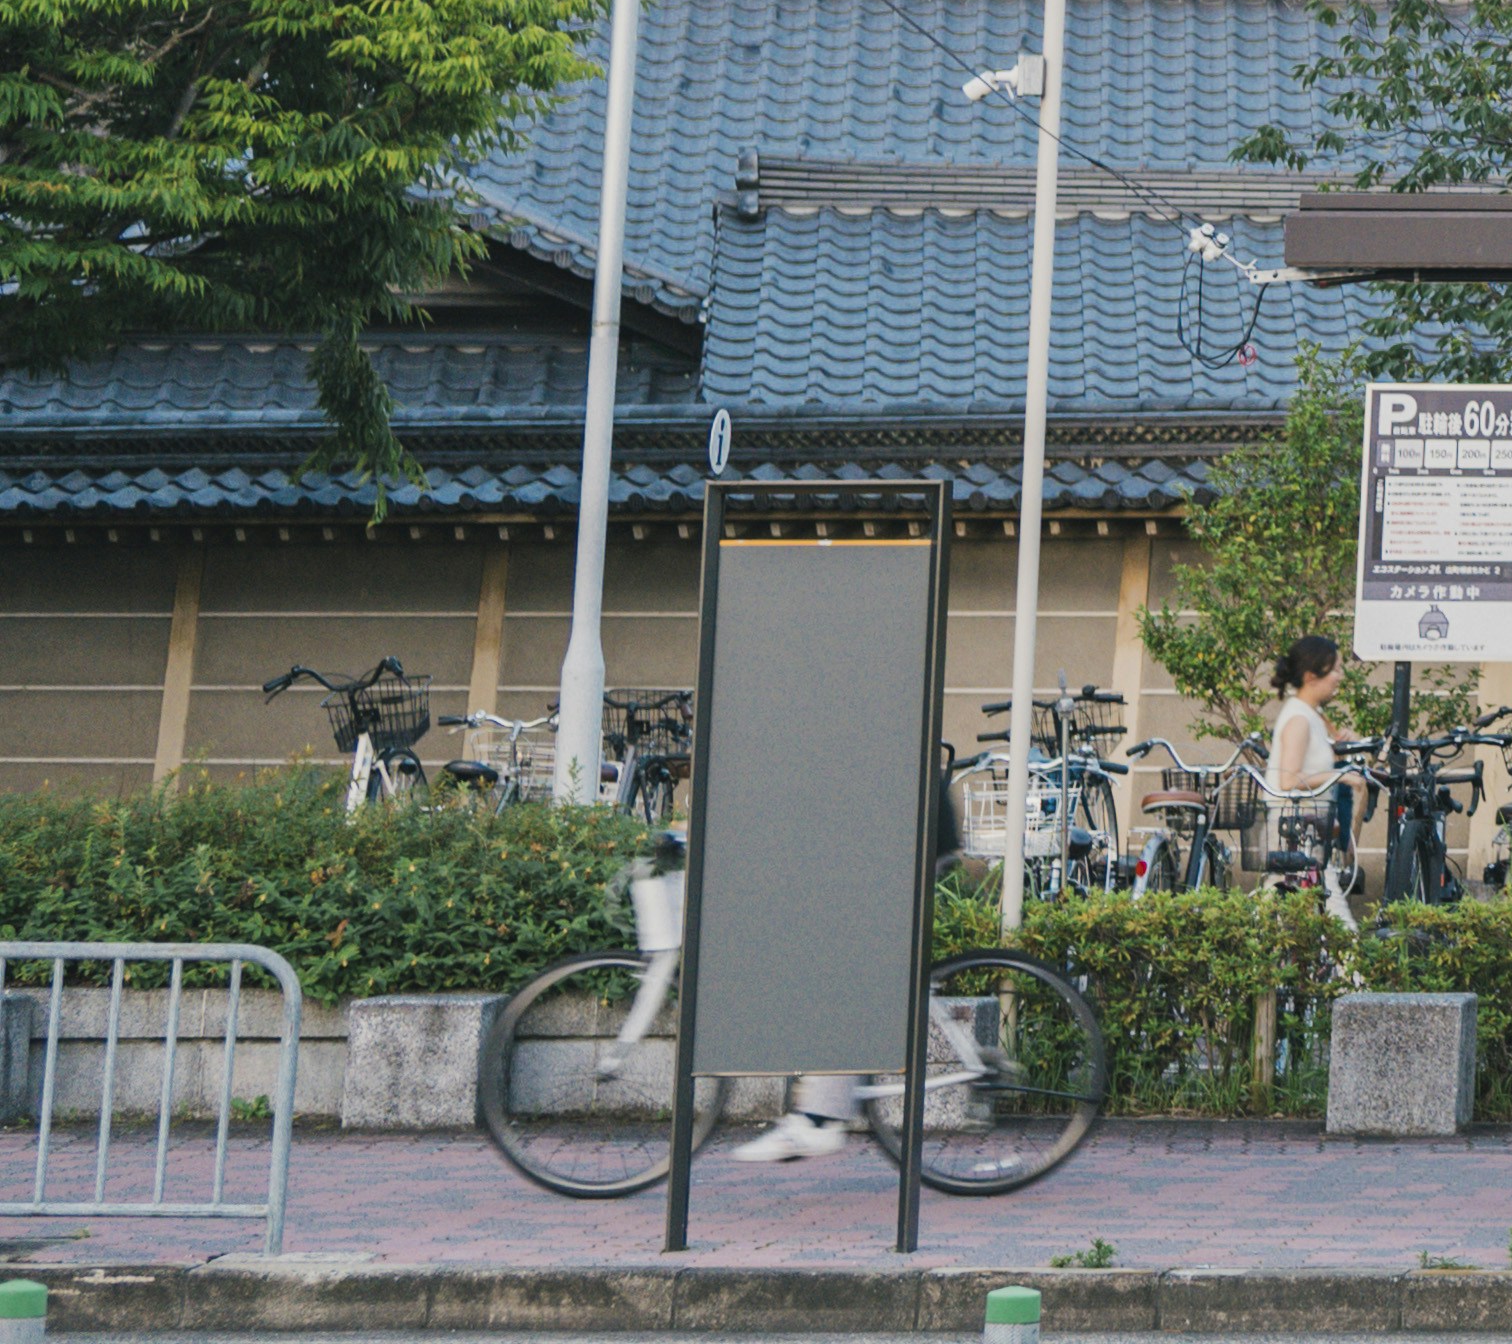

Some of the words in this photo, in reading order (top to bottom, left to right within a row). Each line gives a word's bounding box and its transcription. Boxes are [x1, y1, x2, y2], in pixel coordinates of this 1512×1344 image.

[1379, 393, 1418, 435] P
[1390, 584, 1480, 600] カメラ作動中
